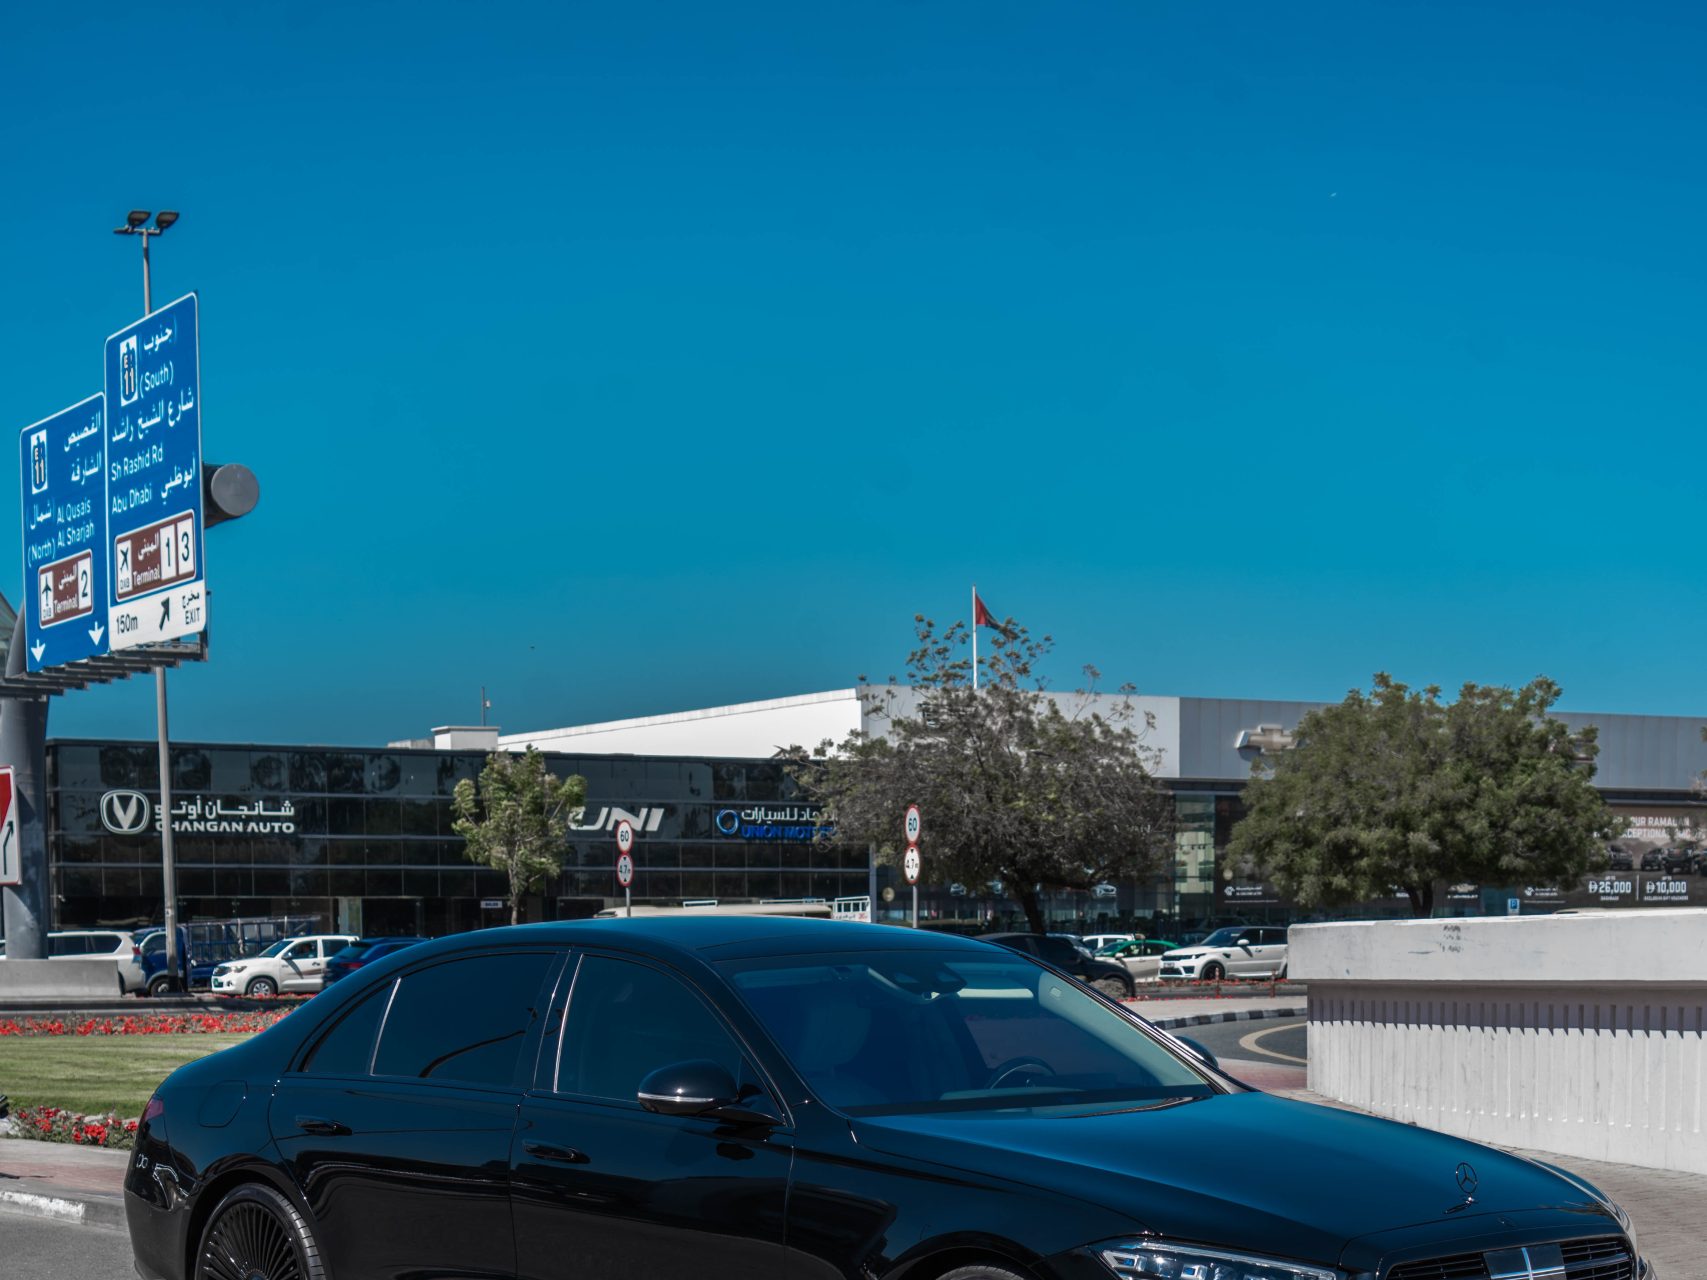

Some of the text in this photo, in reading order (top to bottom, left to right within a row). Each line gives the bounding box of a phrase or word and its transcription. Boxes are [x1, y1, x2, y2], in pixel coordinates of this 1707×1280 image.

[124, 354, 129, 368] E
[124, 367, 135, 395] 11
[140, 360, 173, 398] (South)
[112, 387, 194, 442] شارع الشيخ راشد
[64, 409, 101, 452] القصيص
[35, 459, 44, 485] 11
[71, 450, 102, 486] الشارقة
[111, 442, 163, 481] Sh Rashid Rd
[66, 497, 91, 521] Qusais
[112, 483, 152, 514] Abu Dhabi
[66, 519, 94, 546] Sharjah
[28, 537, 55, 568] (North)
[165, 537, 171, 567] 1
[181, 531, 190, 562] 3
[81, 569, 88, 598] 2
[132, 564, 161, 587] Terminal
[54, 594, 77, 614] Terminal
[182, 590, 200, 609] مخرج
[116, 613, 138, 635] 150m
[185, 607, 200, 625] EXIT
[247, 821, 295, 833] AUTO
[567, 806, 664, 831] UNI
[741, 807, 798, 824] للسيارات
[908, 817, 918, 832] 60
[620, 830, 629, 842] 60
[741, 825, 780, 838] UNION
